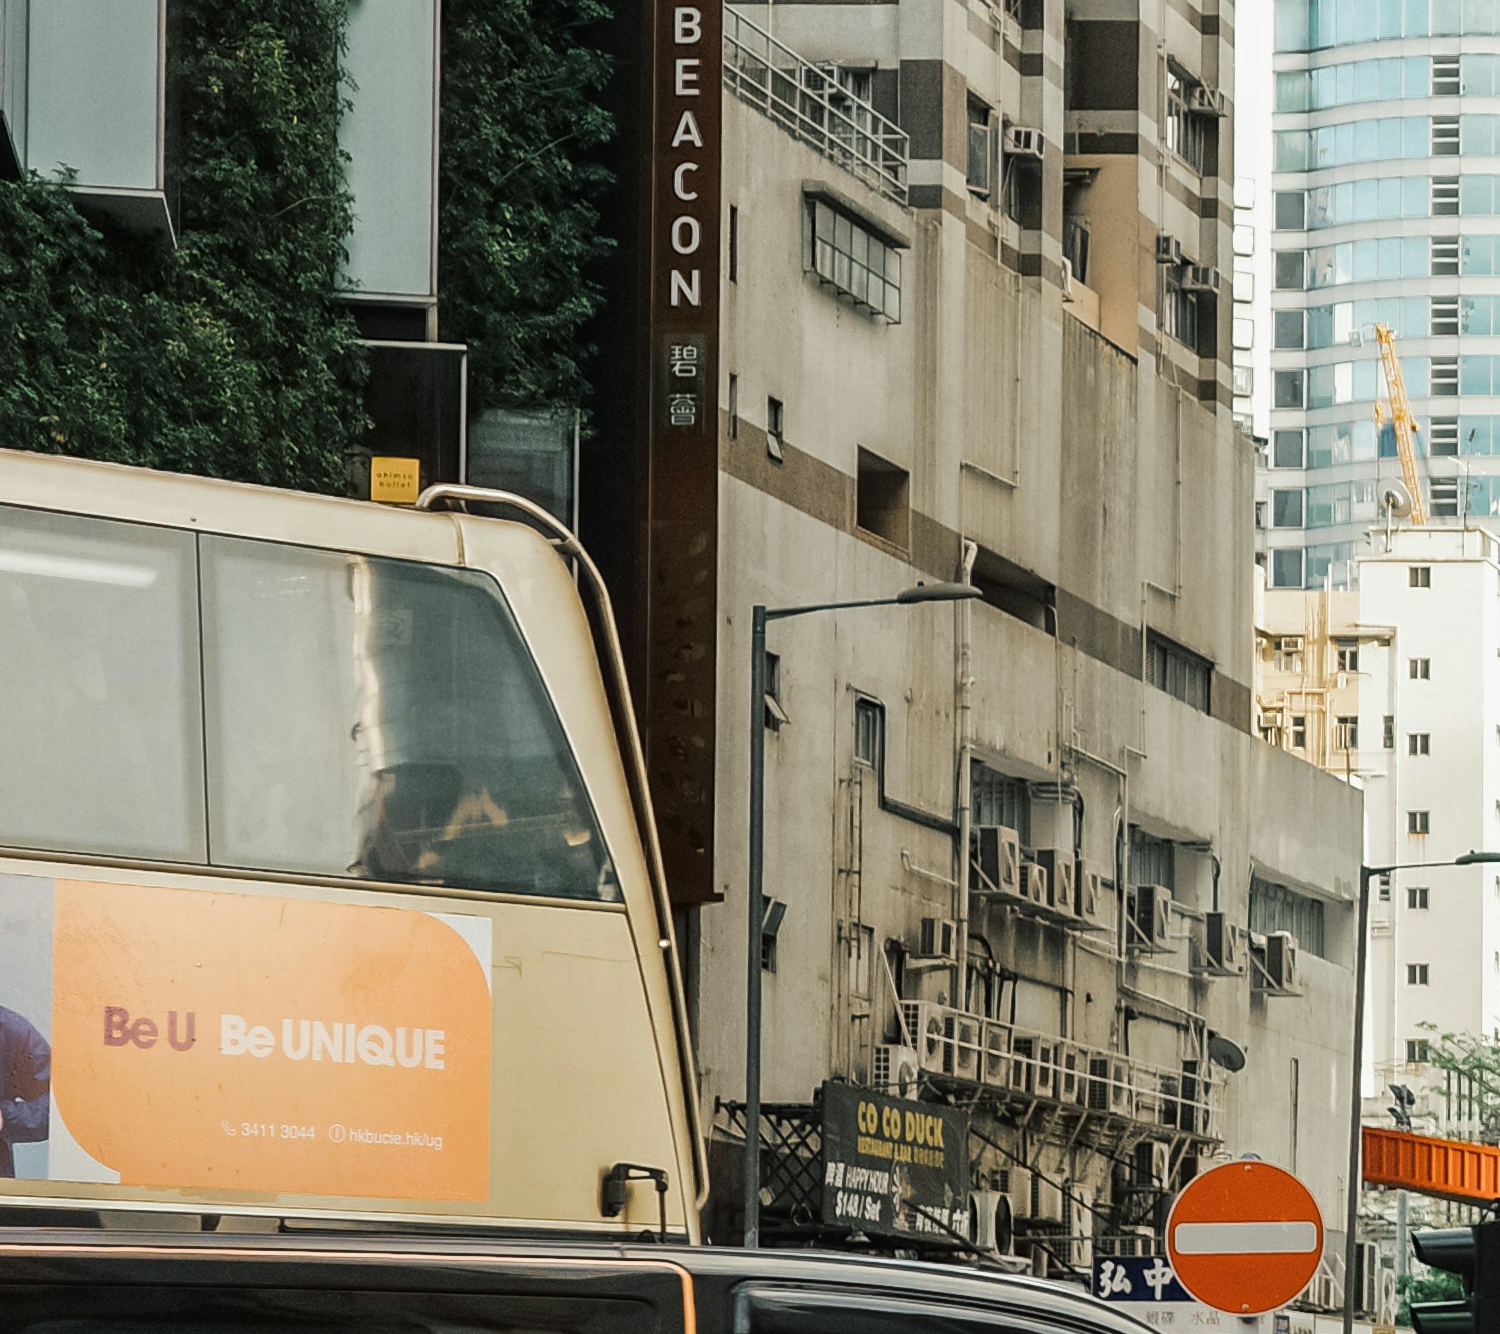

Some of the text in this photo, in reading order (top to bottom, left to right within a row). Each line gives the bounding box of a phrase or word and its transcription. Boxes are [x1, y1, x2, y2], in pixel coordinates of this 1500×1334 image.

[669, 6, 704, 309] BEACON
[103, 1006, 446, 1071] Be U Be UNIQUE
[241, 1122, 443, 1151] 3411 3044 hkbucie.hk/ug
[858, 1101, 944, 1148] CO CO DUCK
[846, 1166, 868, 1191] HAPPY
[868, 1170, 889, 1195] HOUR
